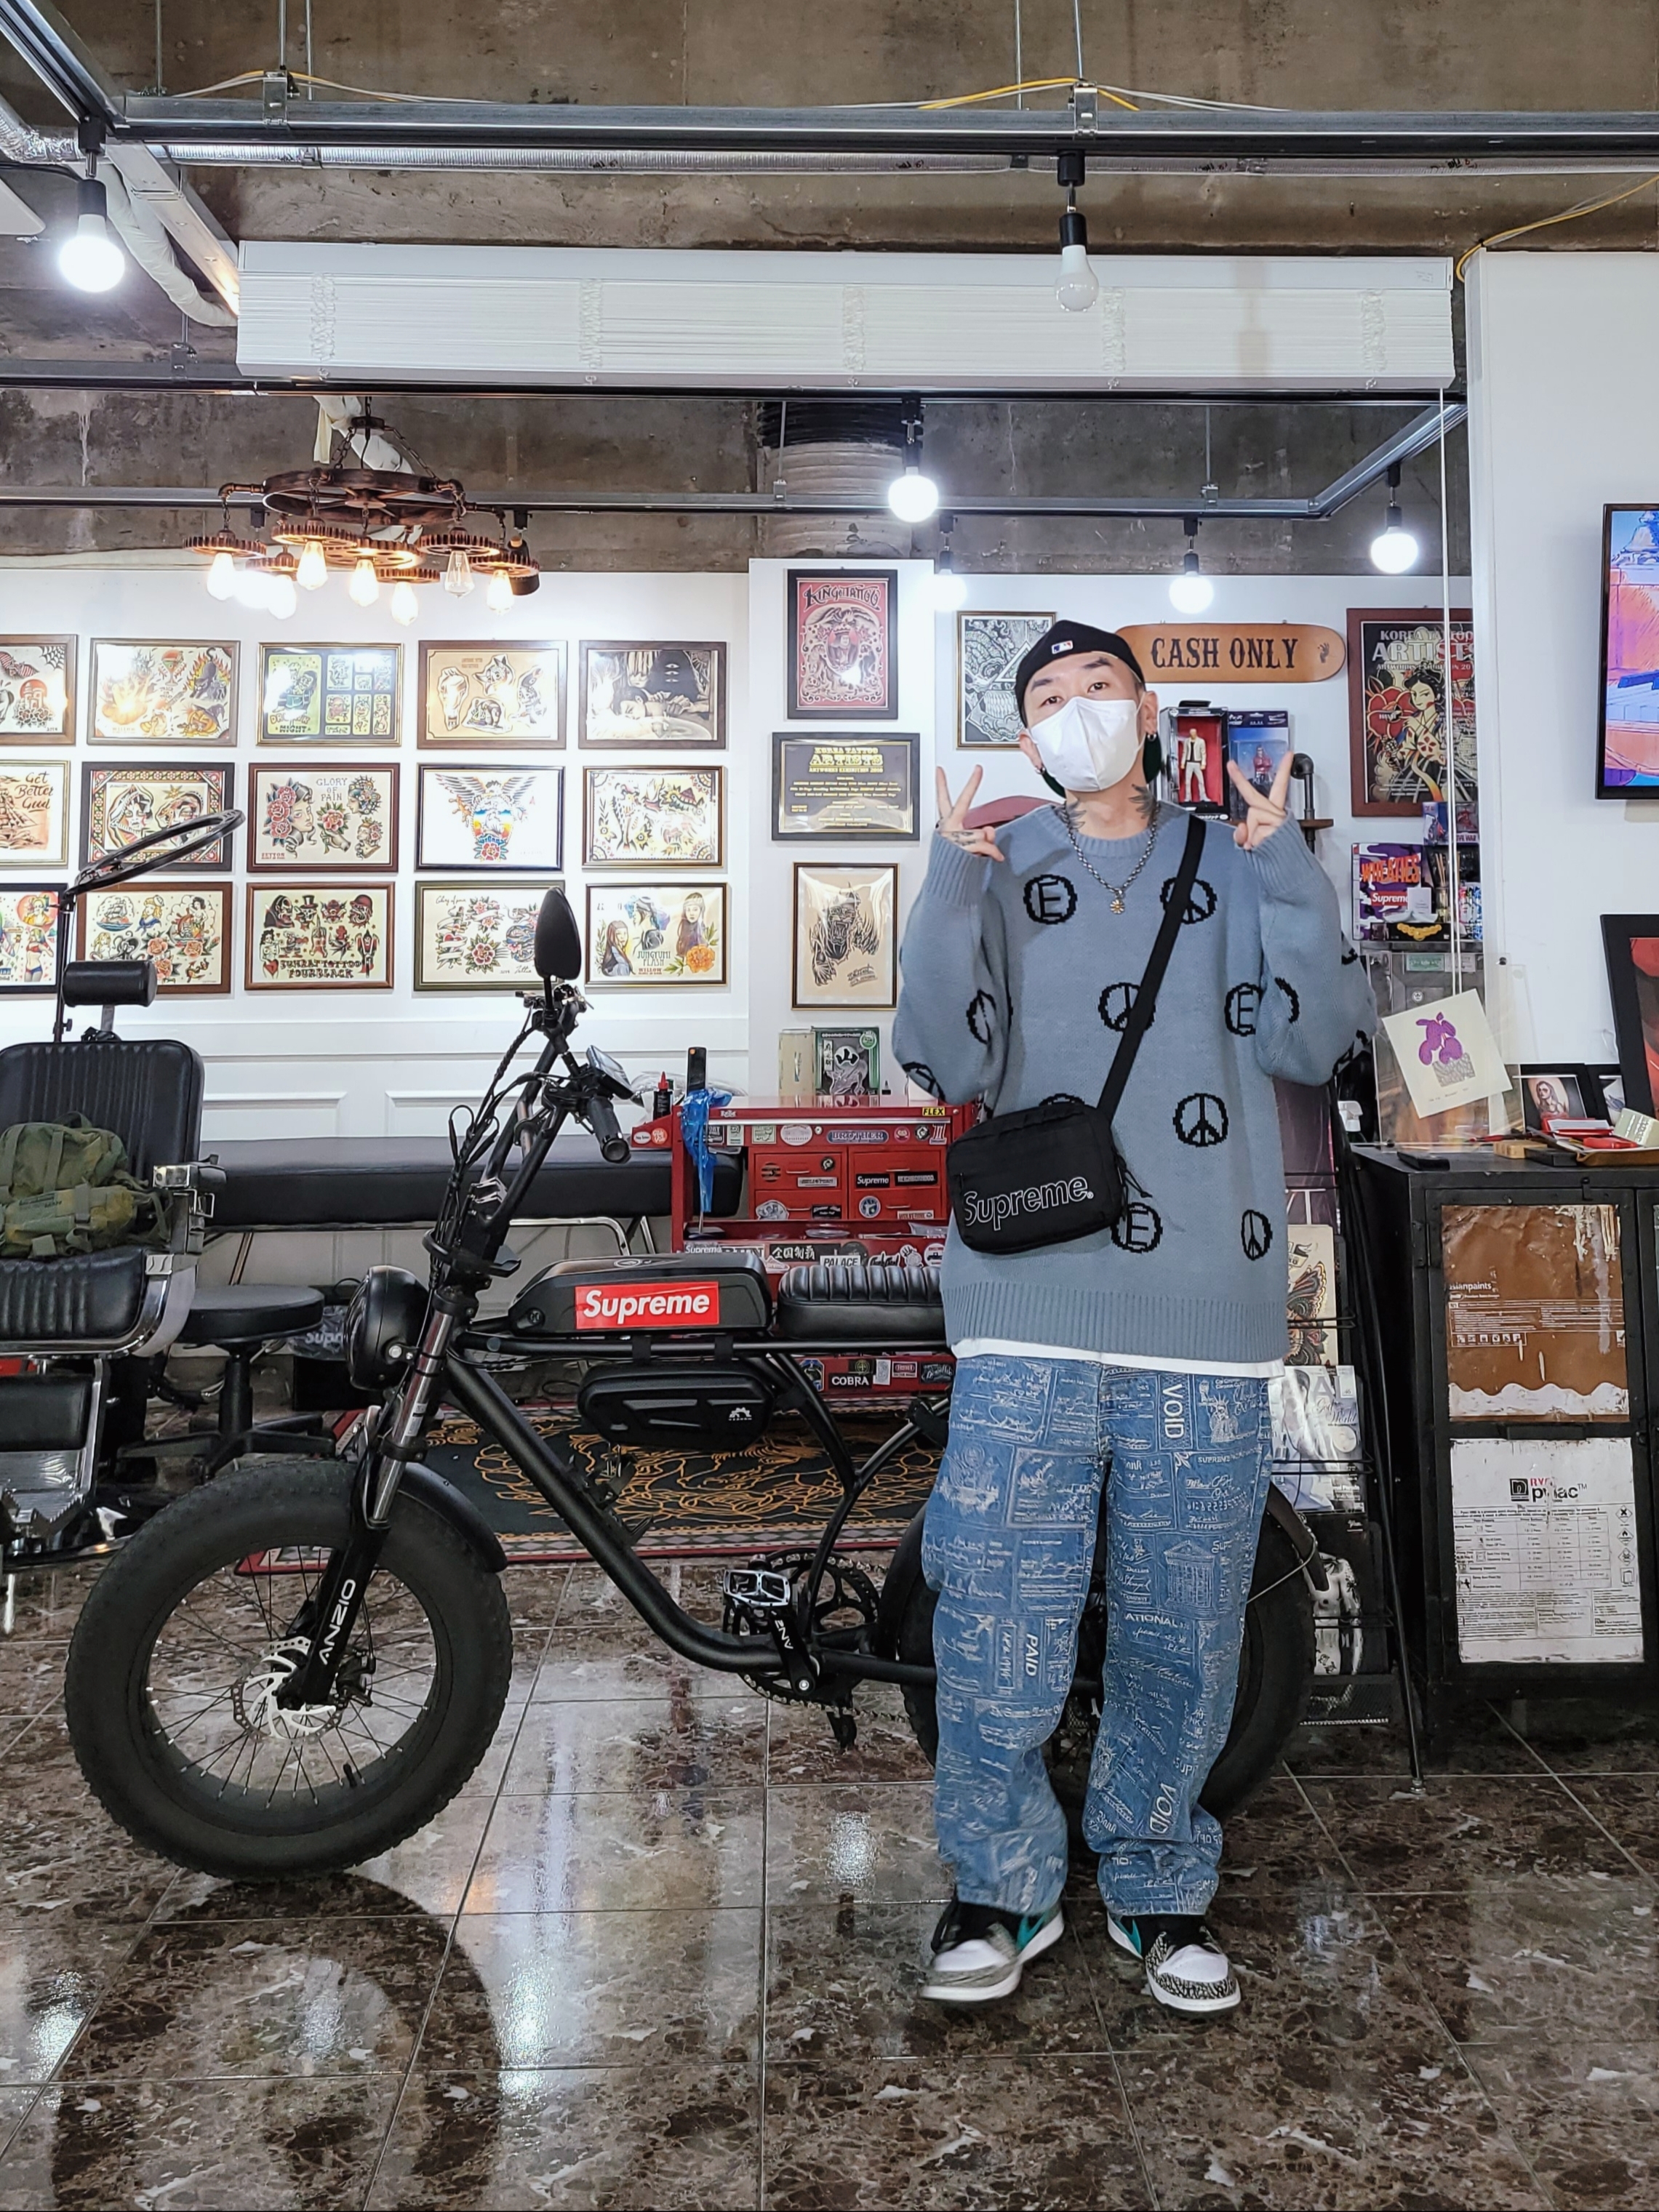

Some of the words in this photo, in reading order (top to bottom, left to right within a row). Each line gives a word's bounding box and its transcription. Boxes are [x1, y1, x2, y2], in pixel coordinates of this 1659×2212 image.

[803, 585, 839, 611] KING
[1380, 630, 1424, 641] KOREA
[1151, 637, 1220, 669] CASH
[1229, 637, 1298, 669] ONLY
[809, 754, 884, 766] ARTISTS
[25, 771, 49, 784] Get
[316, 777, 348, 786] GLORY
[15, 785, 53, 799] Better
[1362, 853, 1420, 883] WHEATIES
[831, 1131, 884, 1142] BROTHER
[857, 1175, 890, 1187] Supreme
[823, 1257, 858, 1267] PALACE
[583, 1289, 710, 1324] Supreme
[831, 1376, 869, 1387] COBRA
[1162, 1384, 1185, 1439] VOID
[1026, 1633, 1039, 1677] PAID
[1149, 1783, 1177, 1835] VOID
